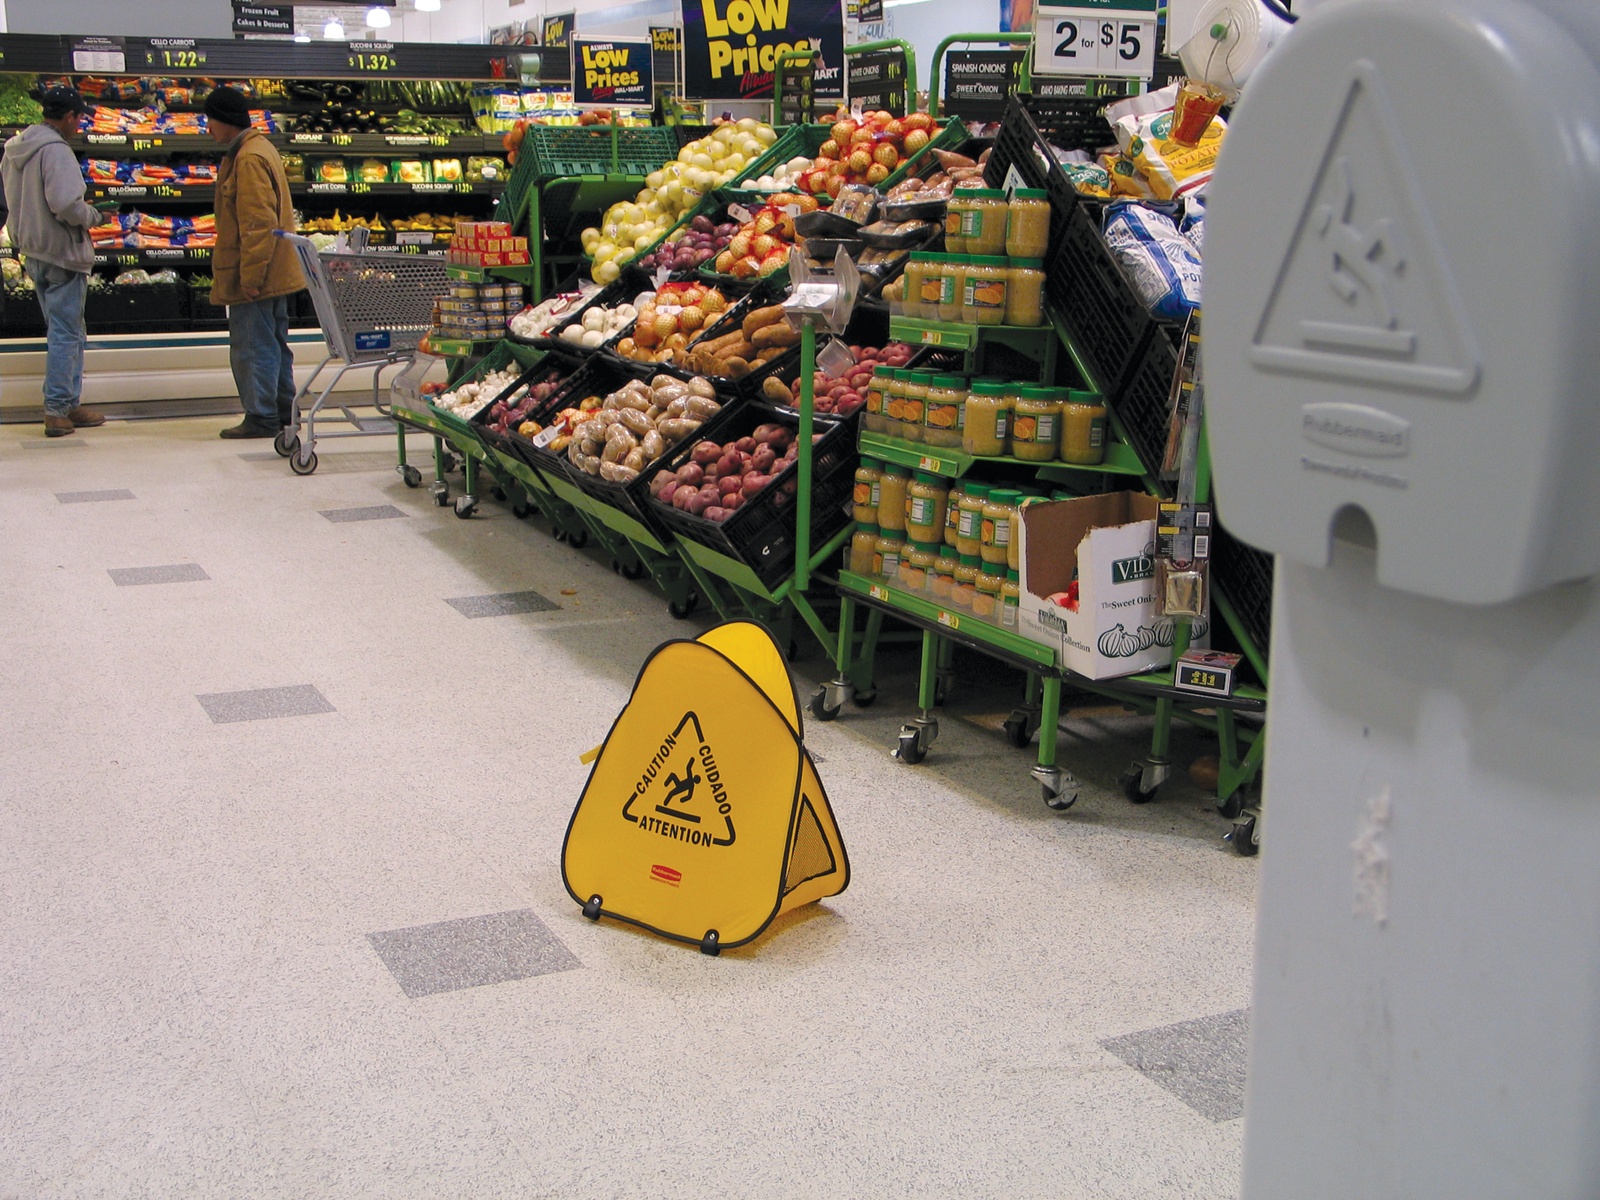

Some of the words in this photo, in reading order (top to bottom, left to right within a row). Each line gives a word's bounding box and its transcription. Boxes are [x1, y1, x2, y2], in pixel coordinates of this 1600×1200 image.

[241, 6, 263, 15] Frozen
[263, 8, 280, 16] Fruit
[701, 0, 789, 38] Low
[236, 18, 256, 27] Cakes
[263, 21, 289, 29] Desserts
[545, 20, 565, 42] Low
[150, 38, 168, 46] CELLO
[652, 28, 676, 42] Low
[1054, 21, 1078, 57] 2
[1081, 38, 1095, 48] for
[1100, 22, 1114, 48] $
[1118, 25, 1141, 60] 5
[590, 43, 614, 52] ALWAYS
[164, 50, 198, 67] 1.22
[357, 54, 388, 70] 1.32
[581, 45, 629, 70] Low
[951, 63, 978, 74] SPANISH
[978, 63, 1006, 73] ONIONS
[585, 68, 640, 89] Prices
[955, 84, 978, 93] SWEET
[977, 84, 999, 93] ONION
[330, 183, 346, 191] CORN
[1111, 599, 1135, 610] Sweet
[1060, 632, 1091, 653] Collection
[635, 734, 677, 794] CAUTION
[698, 745, 732, 815] CUIDADO
[639, 815, 713, 847] ATTENTION
[652, 866, 681, 880] Rubbermaid
